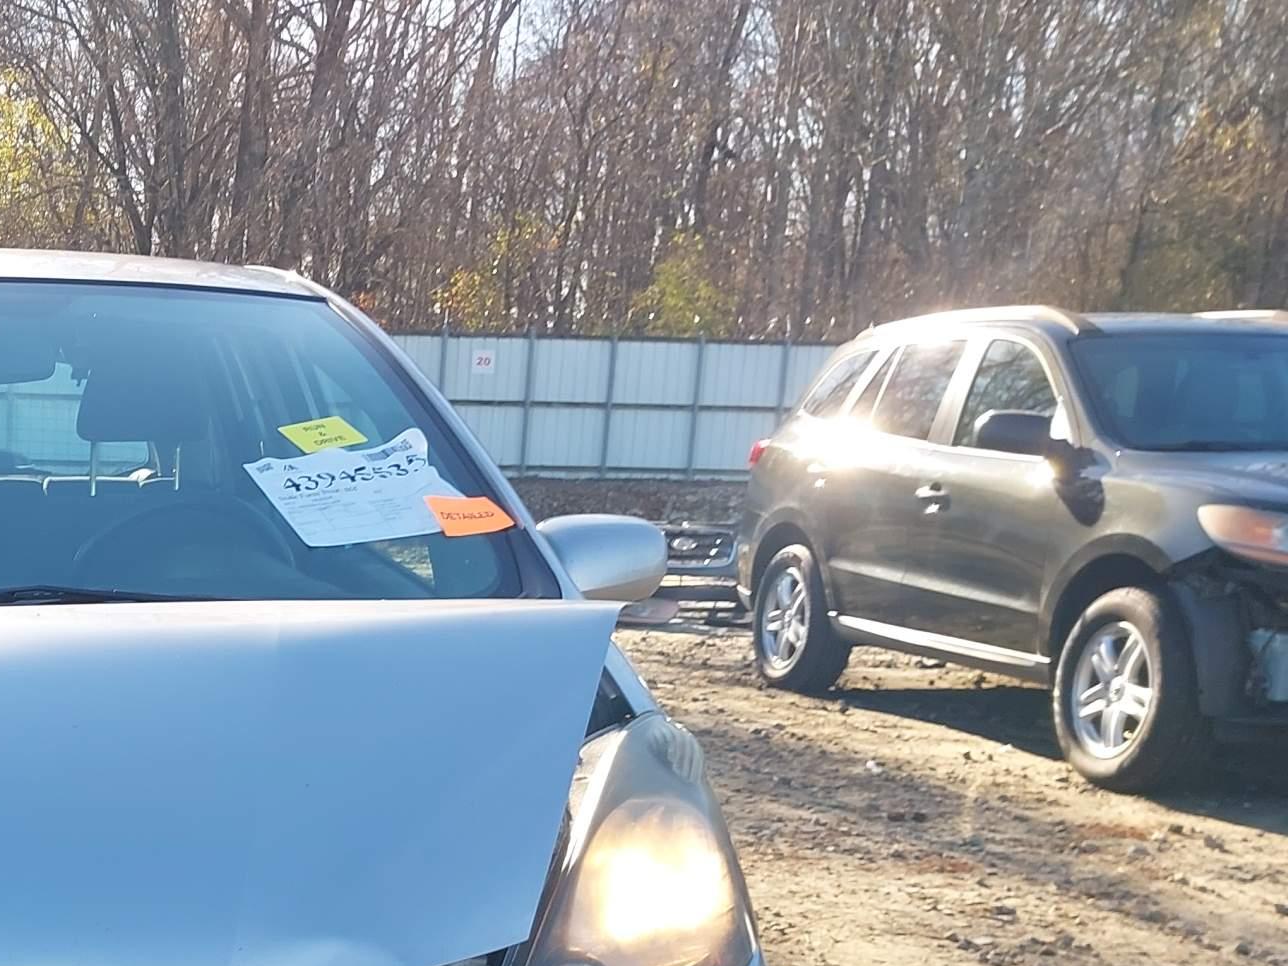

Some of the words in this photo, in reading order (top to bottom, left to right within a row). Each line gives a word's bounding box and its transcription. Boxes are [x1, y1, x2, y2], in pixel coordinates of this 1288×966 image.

[476, 356, 492, 366] 20
[313, 435, 346, 446] DRIVE
[283, 454, 427, 492] 43945535
[440, 511, 495, 521] DETAILED
